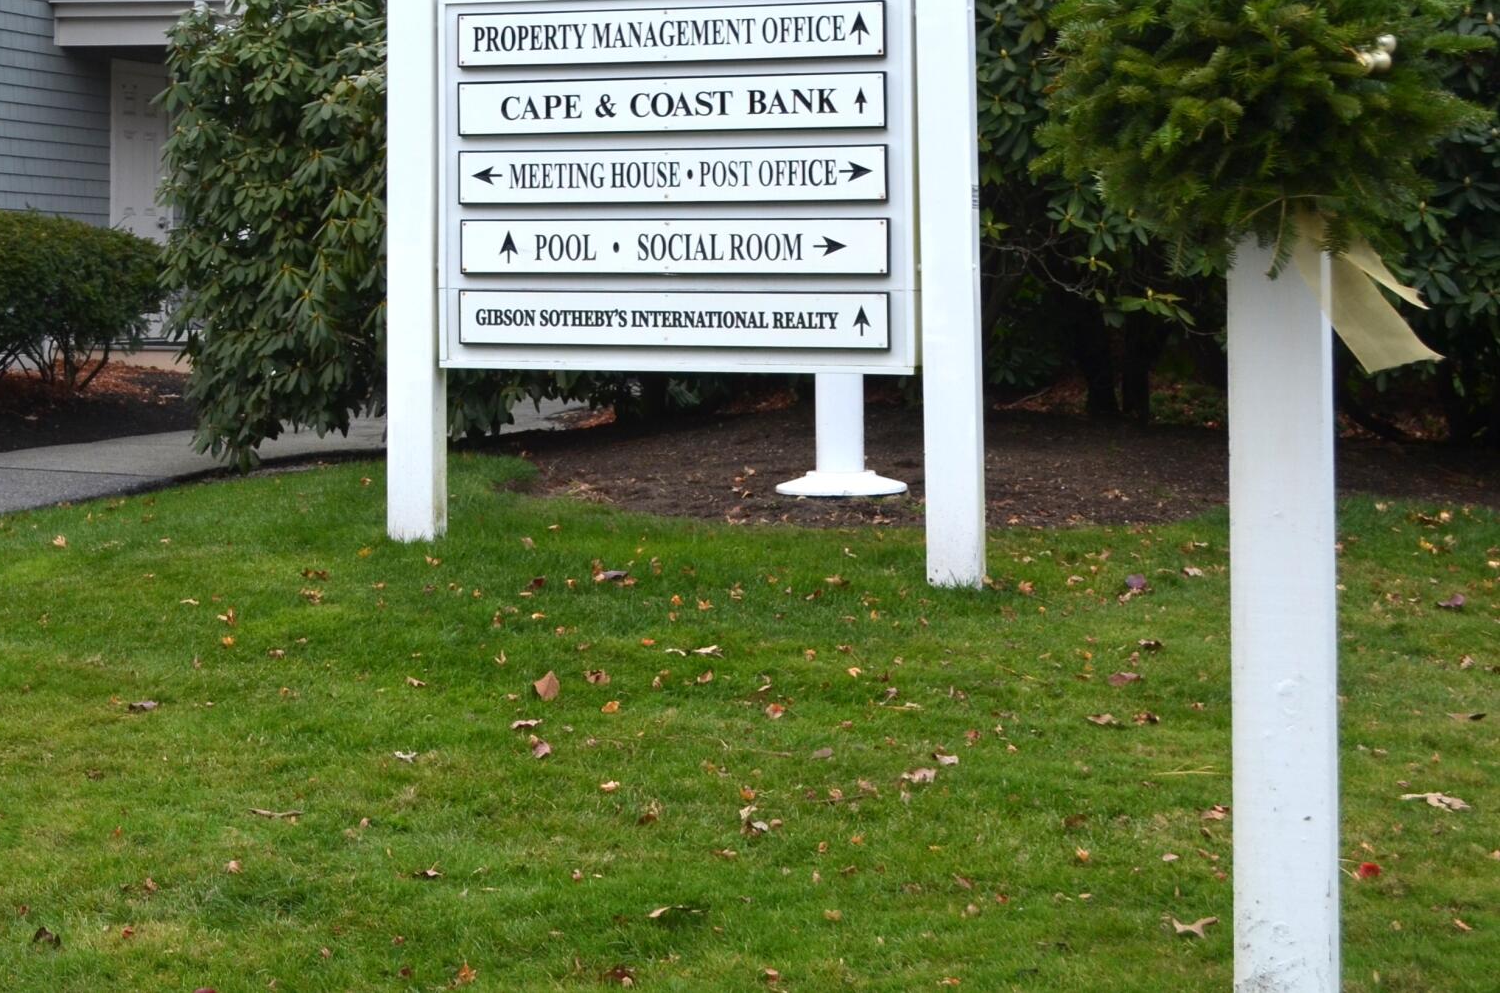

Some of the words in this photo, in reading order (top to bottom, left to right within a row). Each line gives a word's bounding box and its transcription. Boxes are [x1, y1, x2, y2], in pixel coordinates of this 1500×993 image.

[473, 23, 587, 53] PROPERTY
[592, 18, 755, 49] MANAGEMENT
[762, 14, 845, 44] OFFICE
[500, 94, 582, 121] CAPE
[595, 93, 617, 118] &
[629, 90, 734, 118] COAST
[747, 88, 839, 115] BANK
[509, 162, 604, 190] MEETING
[610, 161, 681, 189] HOUSE
[699, 160, 752, 188] POST
[758, 159, 838, 187] OFFICE
[534, 234, 597, 262] POOL
[637, 233, 724, 262] SOCIAL
[729, 233, 803, 262] ROOM
[475, 308, 536, 327] GIBSON
[539, 308, 628, 328] SOTHEBY'S
[630, 310, 768, 329] INTERNATIONAL
[772, 311, 838, 330] REALTY
